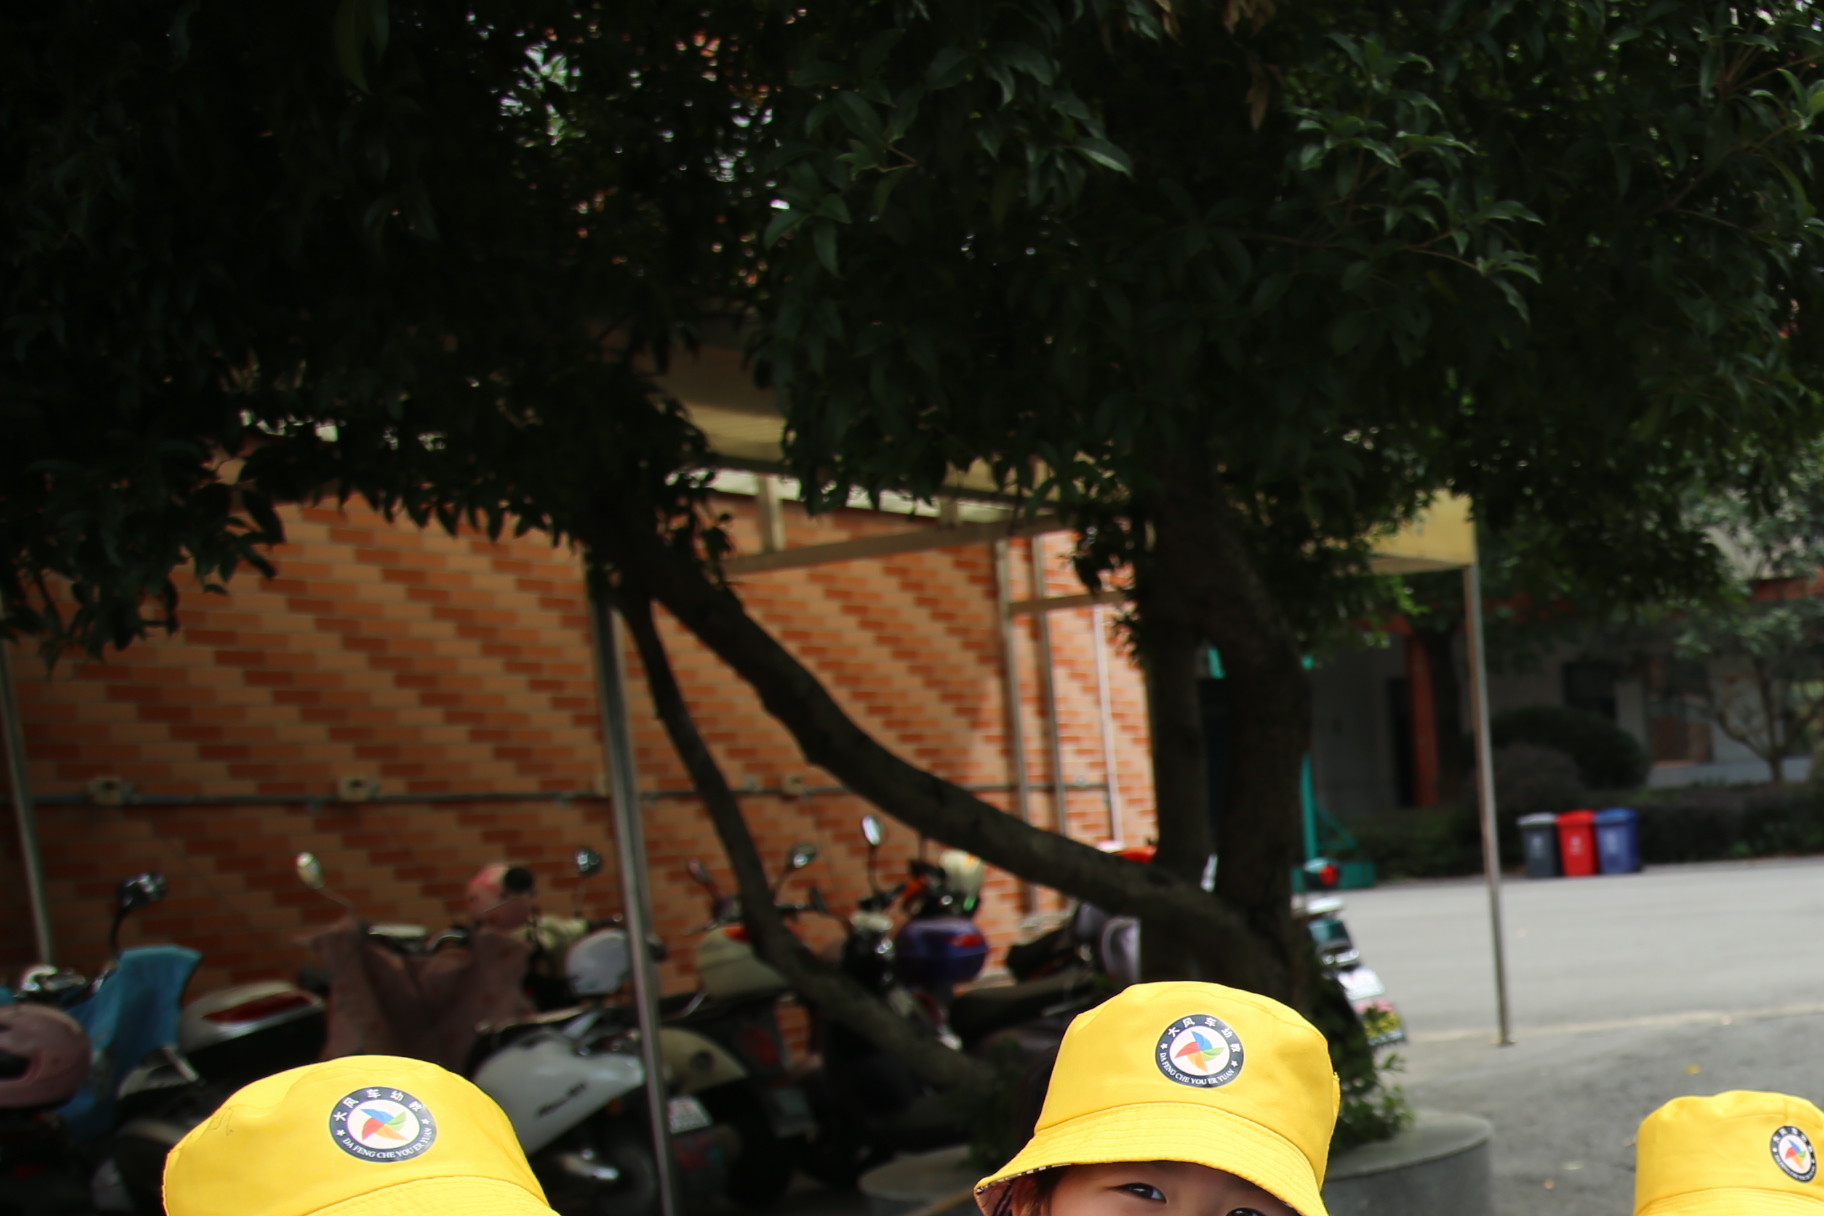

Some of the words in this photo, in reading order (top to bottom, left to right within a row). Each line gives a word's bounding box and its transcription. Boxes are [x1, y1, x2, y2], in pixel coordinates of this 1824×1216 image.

[1162, 1061, 1177, 1075] FENG
[1175, 1073, 1190, 1083] CHE
[1207, 1077, 1218, 1085] ER
[1217, 1068, 1235, 1082] YUAN
[342, 1138, 353, 1149] DA
[352, 1144, 376, 1158] FENG
[376, 1151, 396, 1159] CHE
[395, 1147, 415, 1158] YOU
[413, 1142, 425, 1152] ER
[421, 1127, 432, 1145] YUAN
